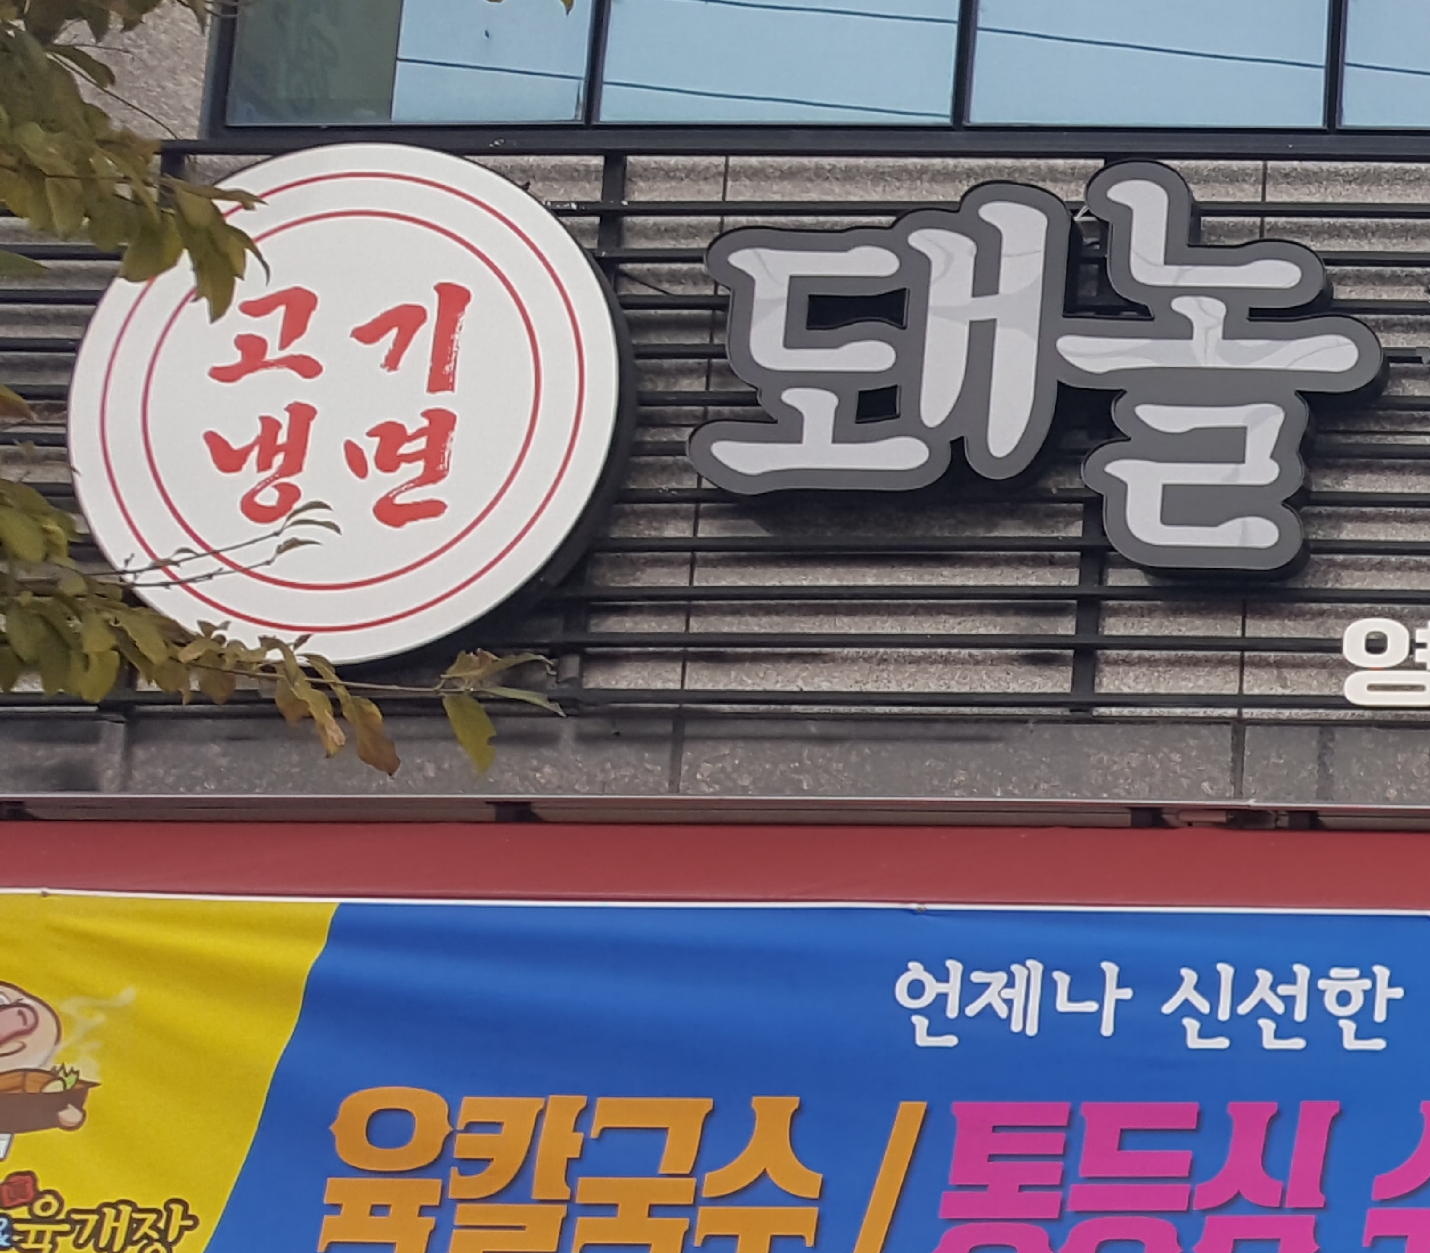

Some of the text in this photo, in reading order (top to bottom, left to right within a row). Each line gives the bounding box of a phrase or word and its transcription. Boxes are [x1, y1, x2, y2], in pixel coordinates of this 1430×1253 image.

[209, 283, 471, 394] 고기
[700, 170, 1372, 558] 돼놀
[204, 402, 457, 528] 냉면
[895, 958, 1133, 1048] 언제나
[1161, 963, 1403, 1051] 신선한
